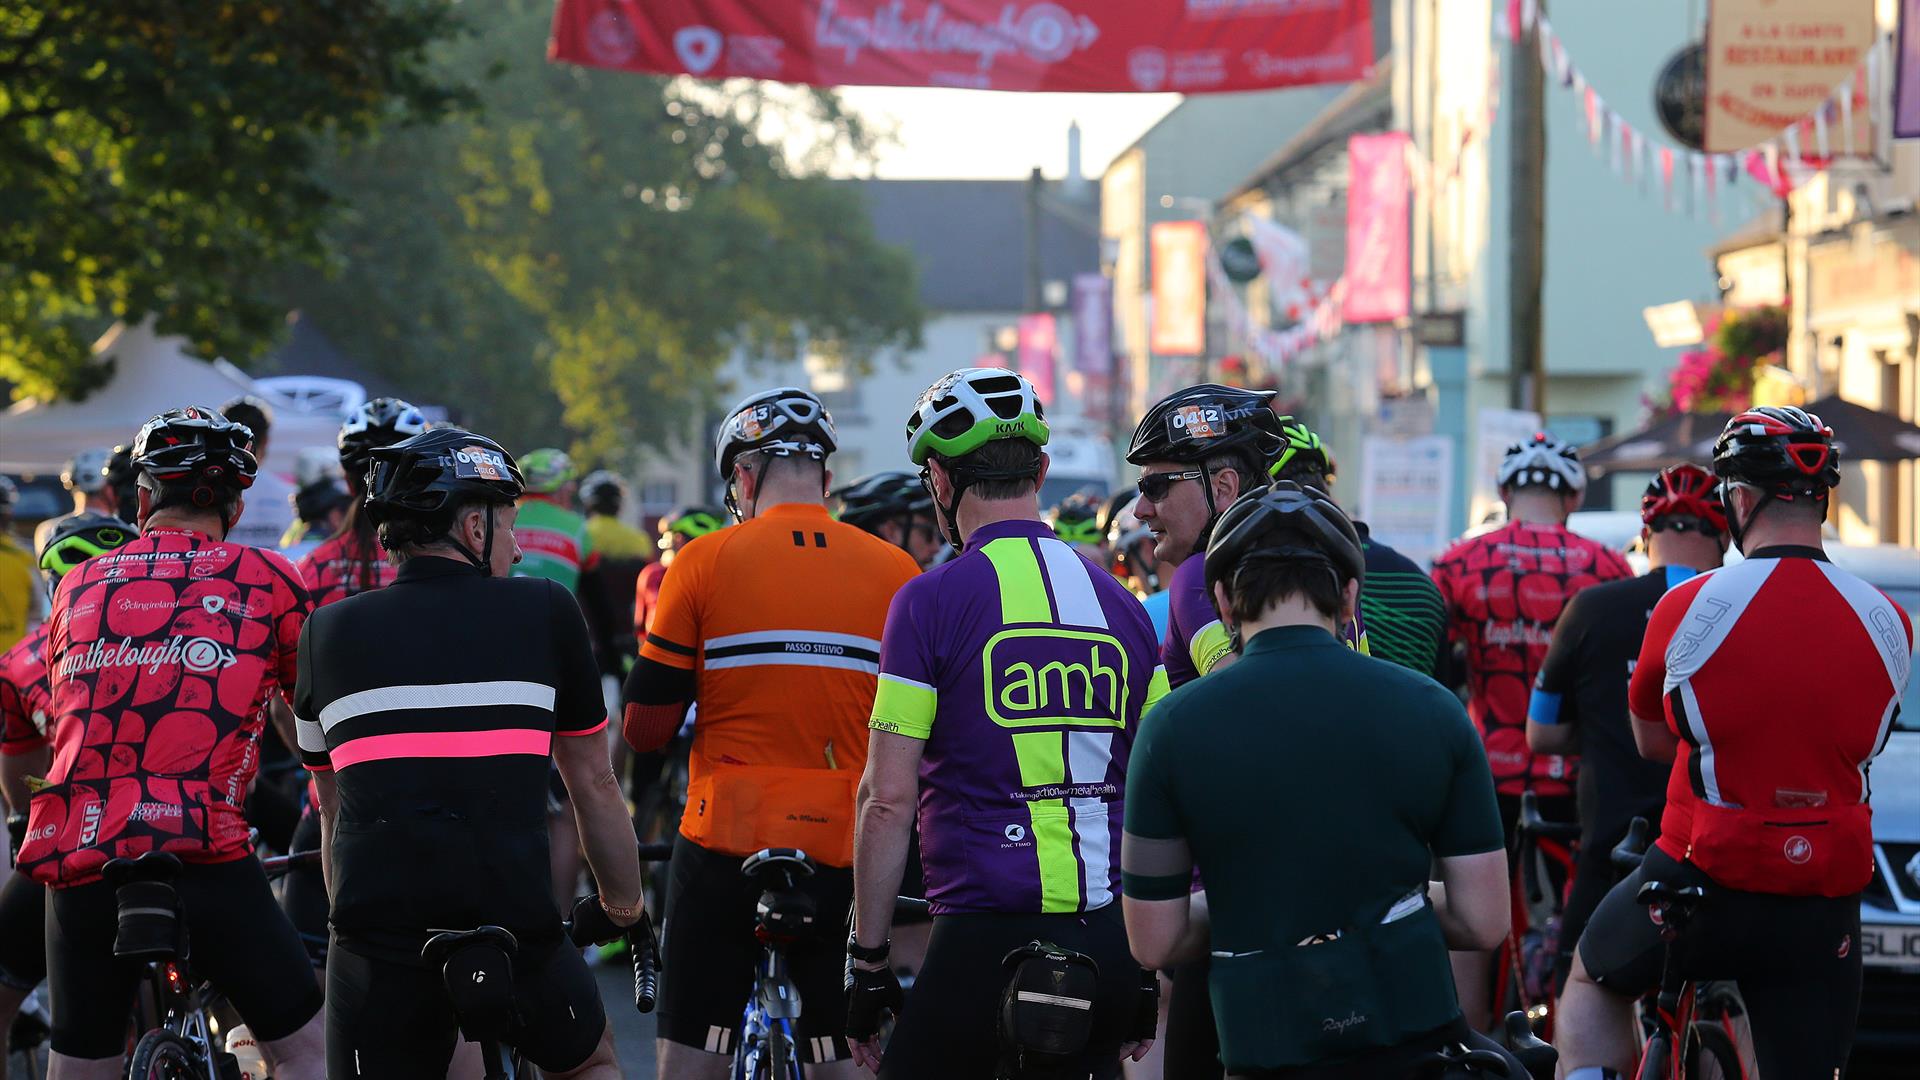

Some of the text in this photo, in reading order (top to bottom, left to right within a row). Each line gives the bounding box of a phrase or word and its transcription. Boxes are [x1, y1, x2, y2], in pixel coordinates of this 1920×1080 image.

[1786, 25, 1846, 38] CARTE
[1724, 45, 1857, 66] RESTAURANT
[1172, 409, 1219, 429] 0412
[456, 451, 504, 470] 0654
[97, 551, 181, 565] Saltmarine
[785, 642, 844, 655] PASSO STELVIO
[1000, 645, 1116, 714] amh
[81, 804, 101, 844] CLIF
[1322, 1011, 1366, 1036] Rapha
